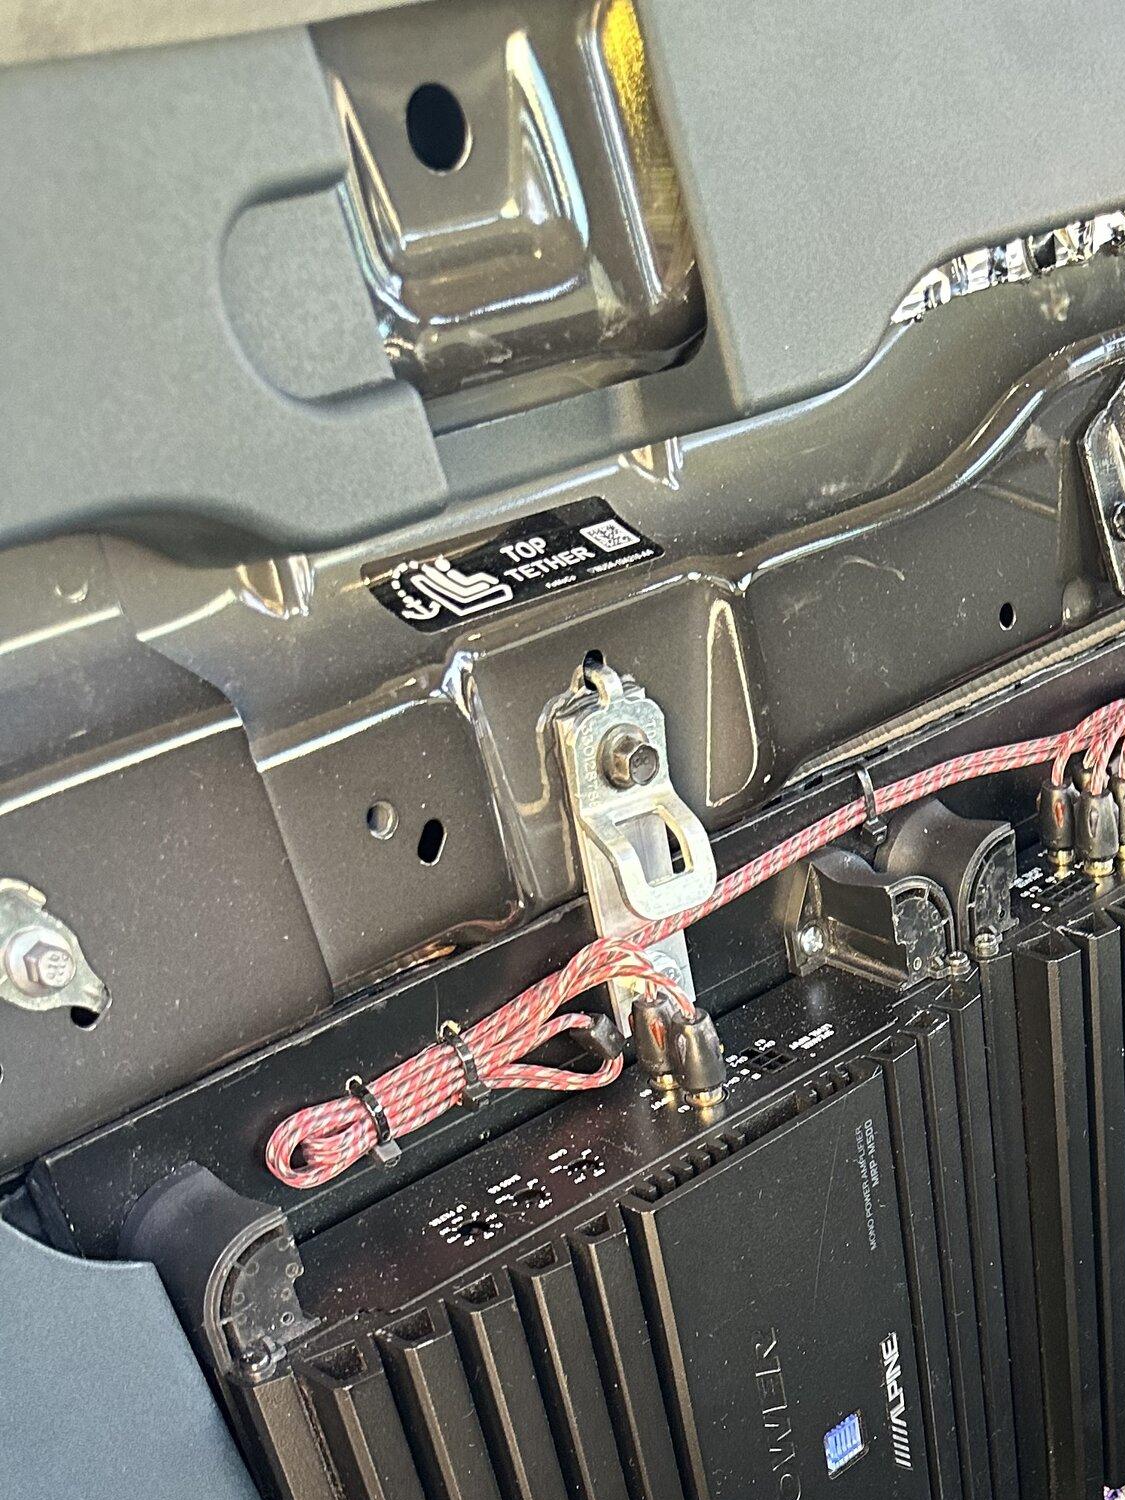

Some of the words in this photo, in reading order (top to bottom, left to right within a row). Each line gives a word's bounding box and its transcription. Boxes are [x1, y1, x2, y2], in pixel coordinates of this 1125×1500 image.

[500, 536, 547, 563] TOP
[503, 547, 596, 582] TETHER
[854, 1125, 869, 1180] AMPLIFIER
[864, 1118, 880, 1188] MRP-M500
[862, 1180, 873, 1218] POWER
[867, 1219, 878, 1251] MONO
